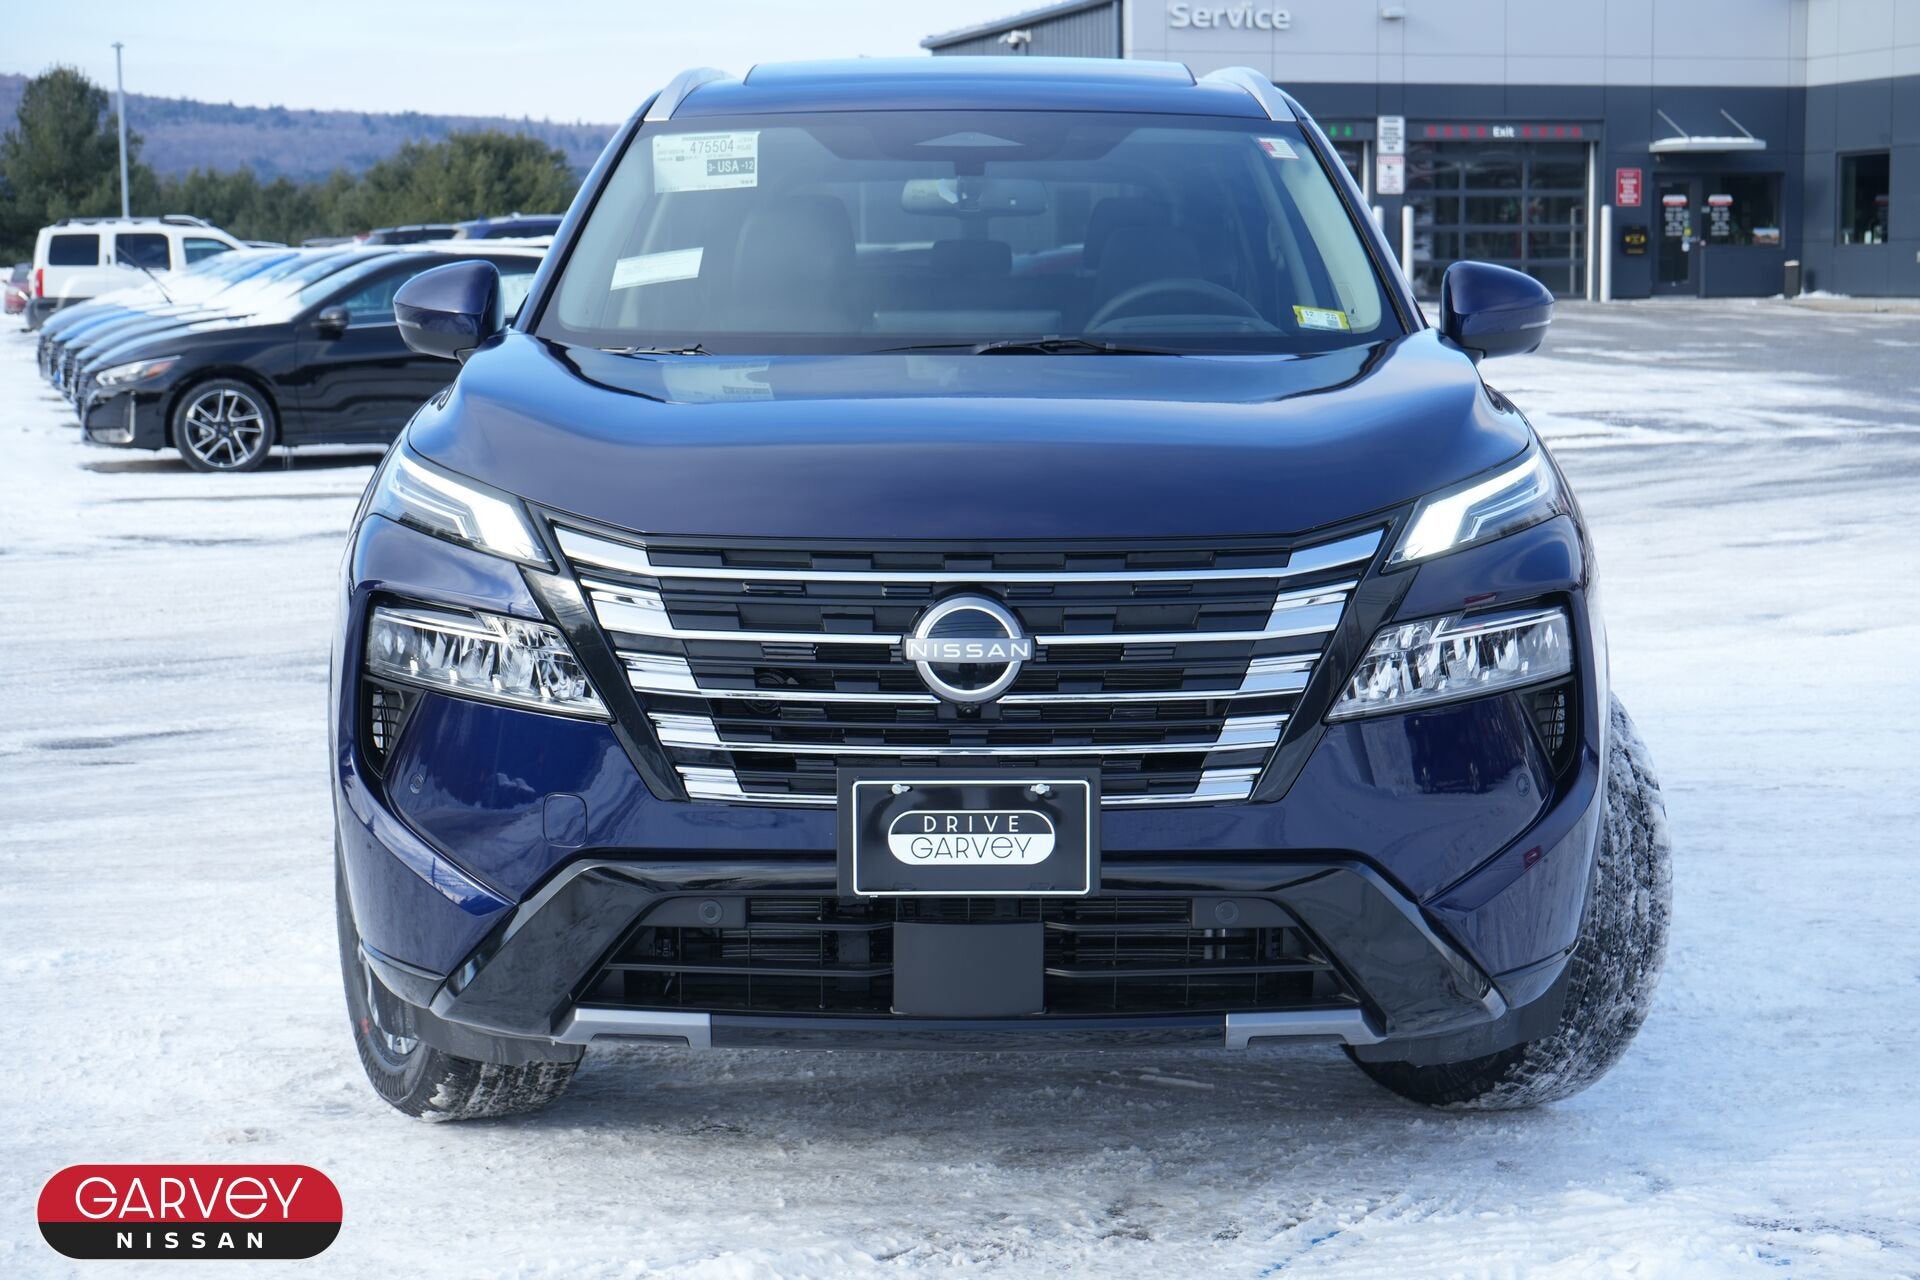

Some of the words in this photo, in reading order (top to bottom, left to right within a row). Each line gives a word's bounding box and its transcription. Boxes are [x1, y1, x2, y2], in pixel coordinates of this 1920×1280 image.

[1169, 2, 1291, 30] Service
[1492, 125, 1515, 138] Exit
[690, 139, 735, 155] 475504
[717, 160, 740, 173] USA
[910, 642, 1029, 658] NISSAN
[924, 815, 1019, 832] DRIVE
